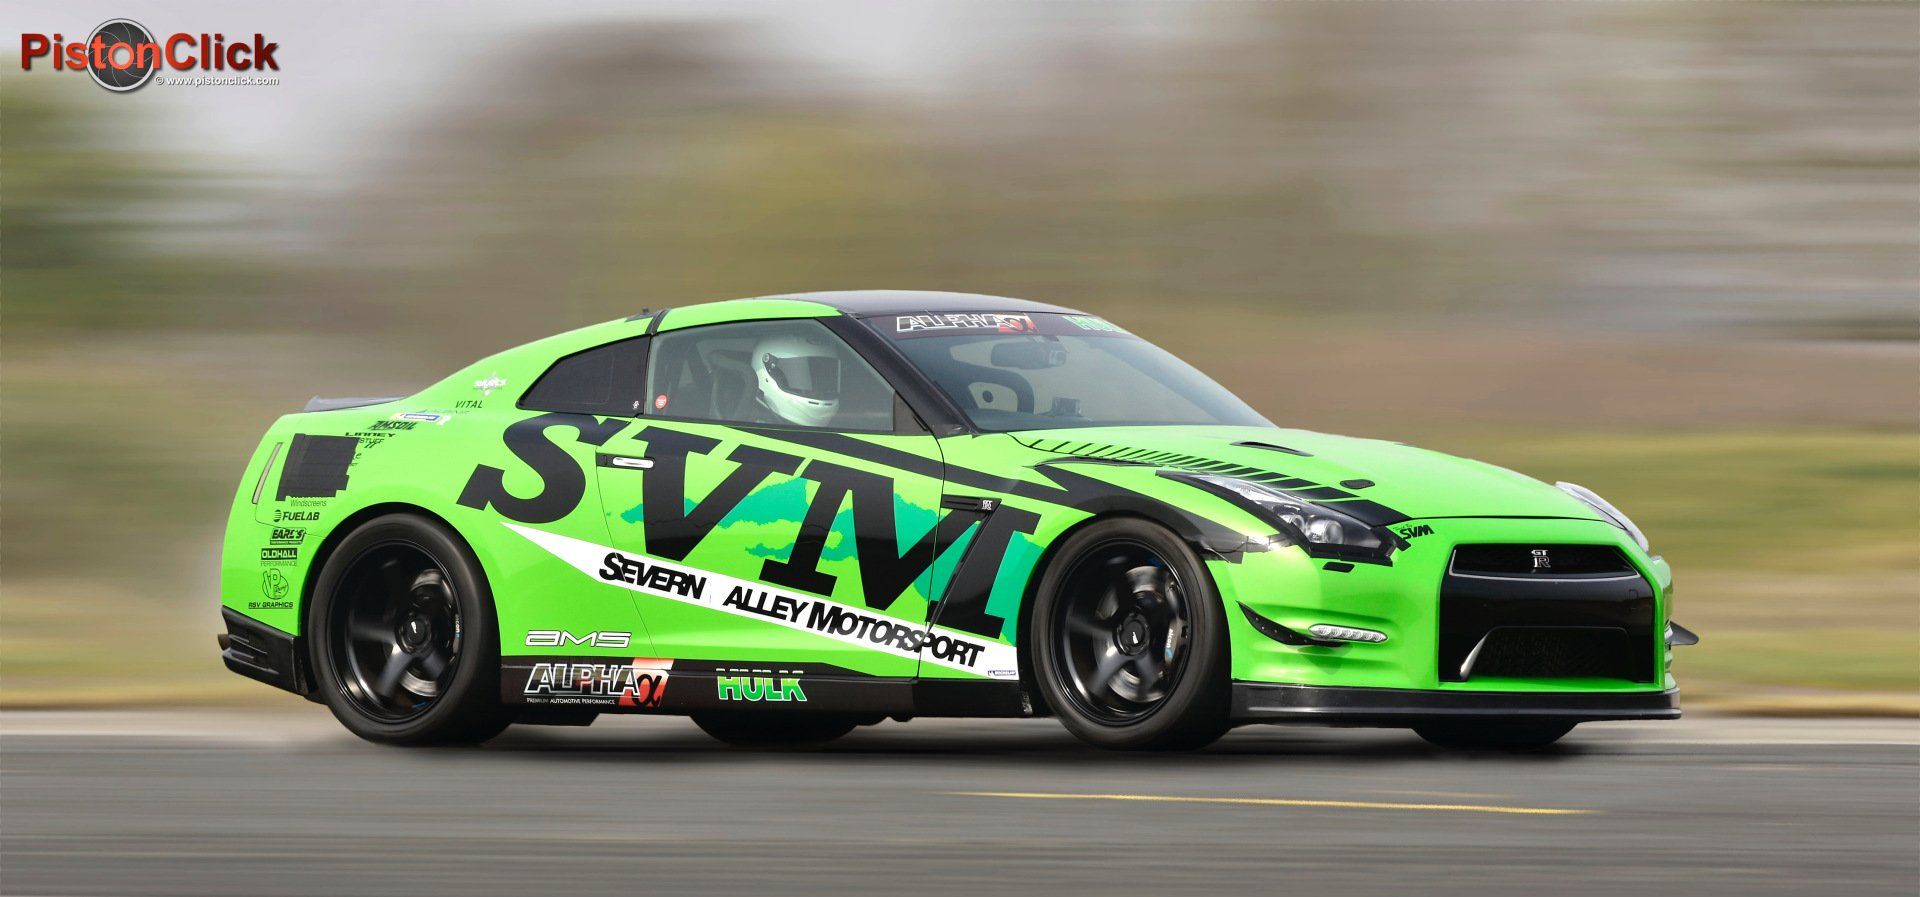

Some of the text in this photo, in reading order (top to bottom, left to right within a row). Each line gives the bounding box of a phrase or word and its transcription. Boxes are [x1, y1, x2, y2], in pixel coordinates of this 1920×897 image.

[896, 313, 1016, 333] ALPHA
[455, 400, 484, 409] VITAL
[282, 511, 320, 521] FUELAB
[456, 412, 1042, 640] SVM
[1399, 524, 1436, 540] SVM
[261, 550, 297, 559] OLDHALL
[598, 552, 707, 600] SEVERN
[806, 601, 986, 668] MOTORSPORT
[523, 662, 641, 697] ALPHA
[715, 667, 808, 702] HULK
